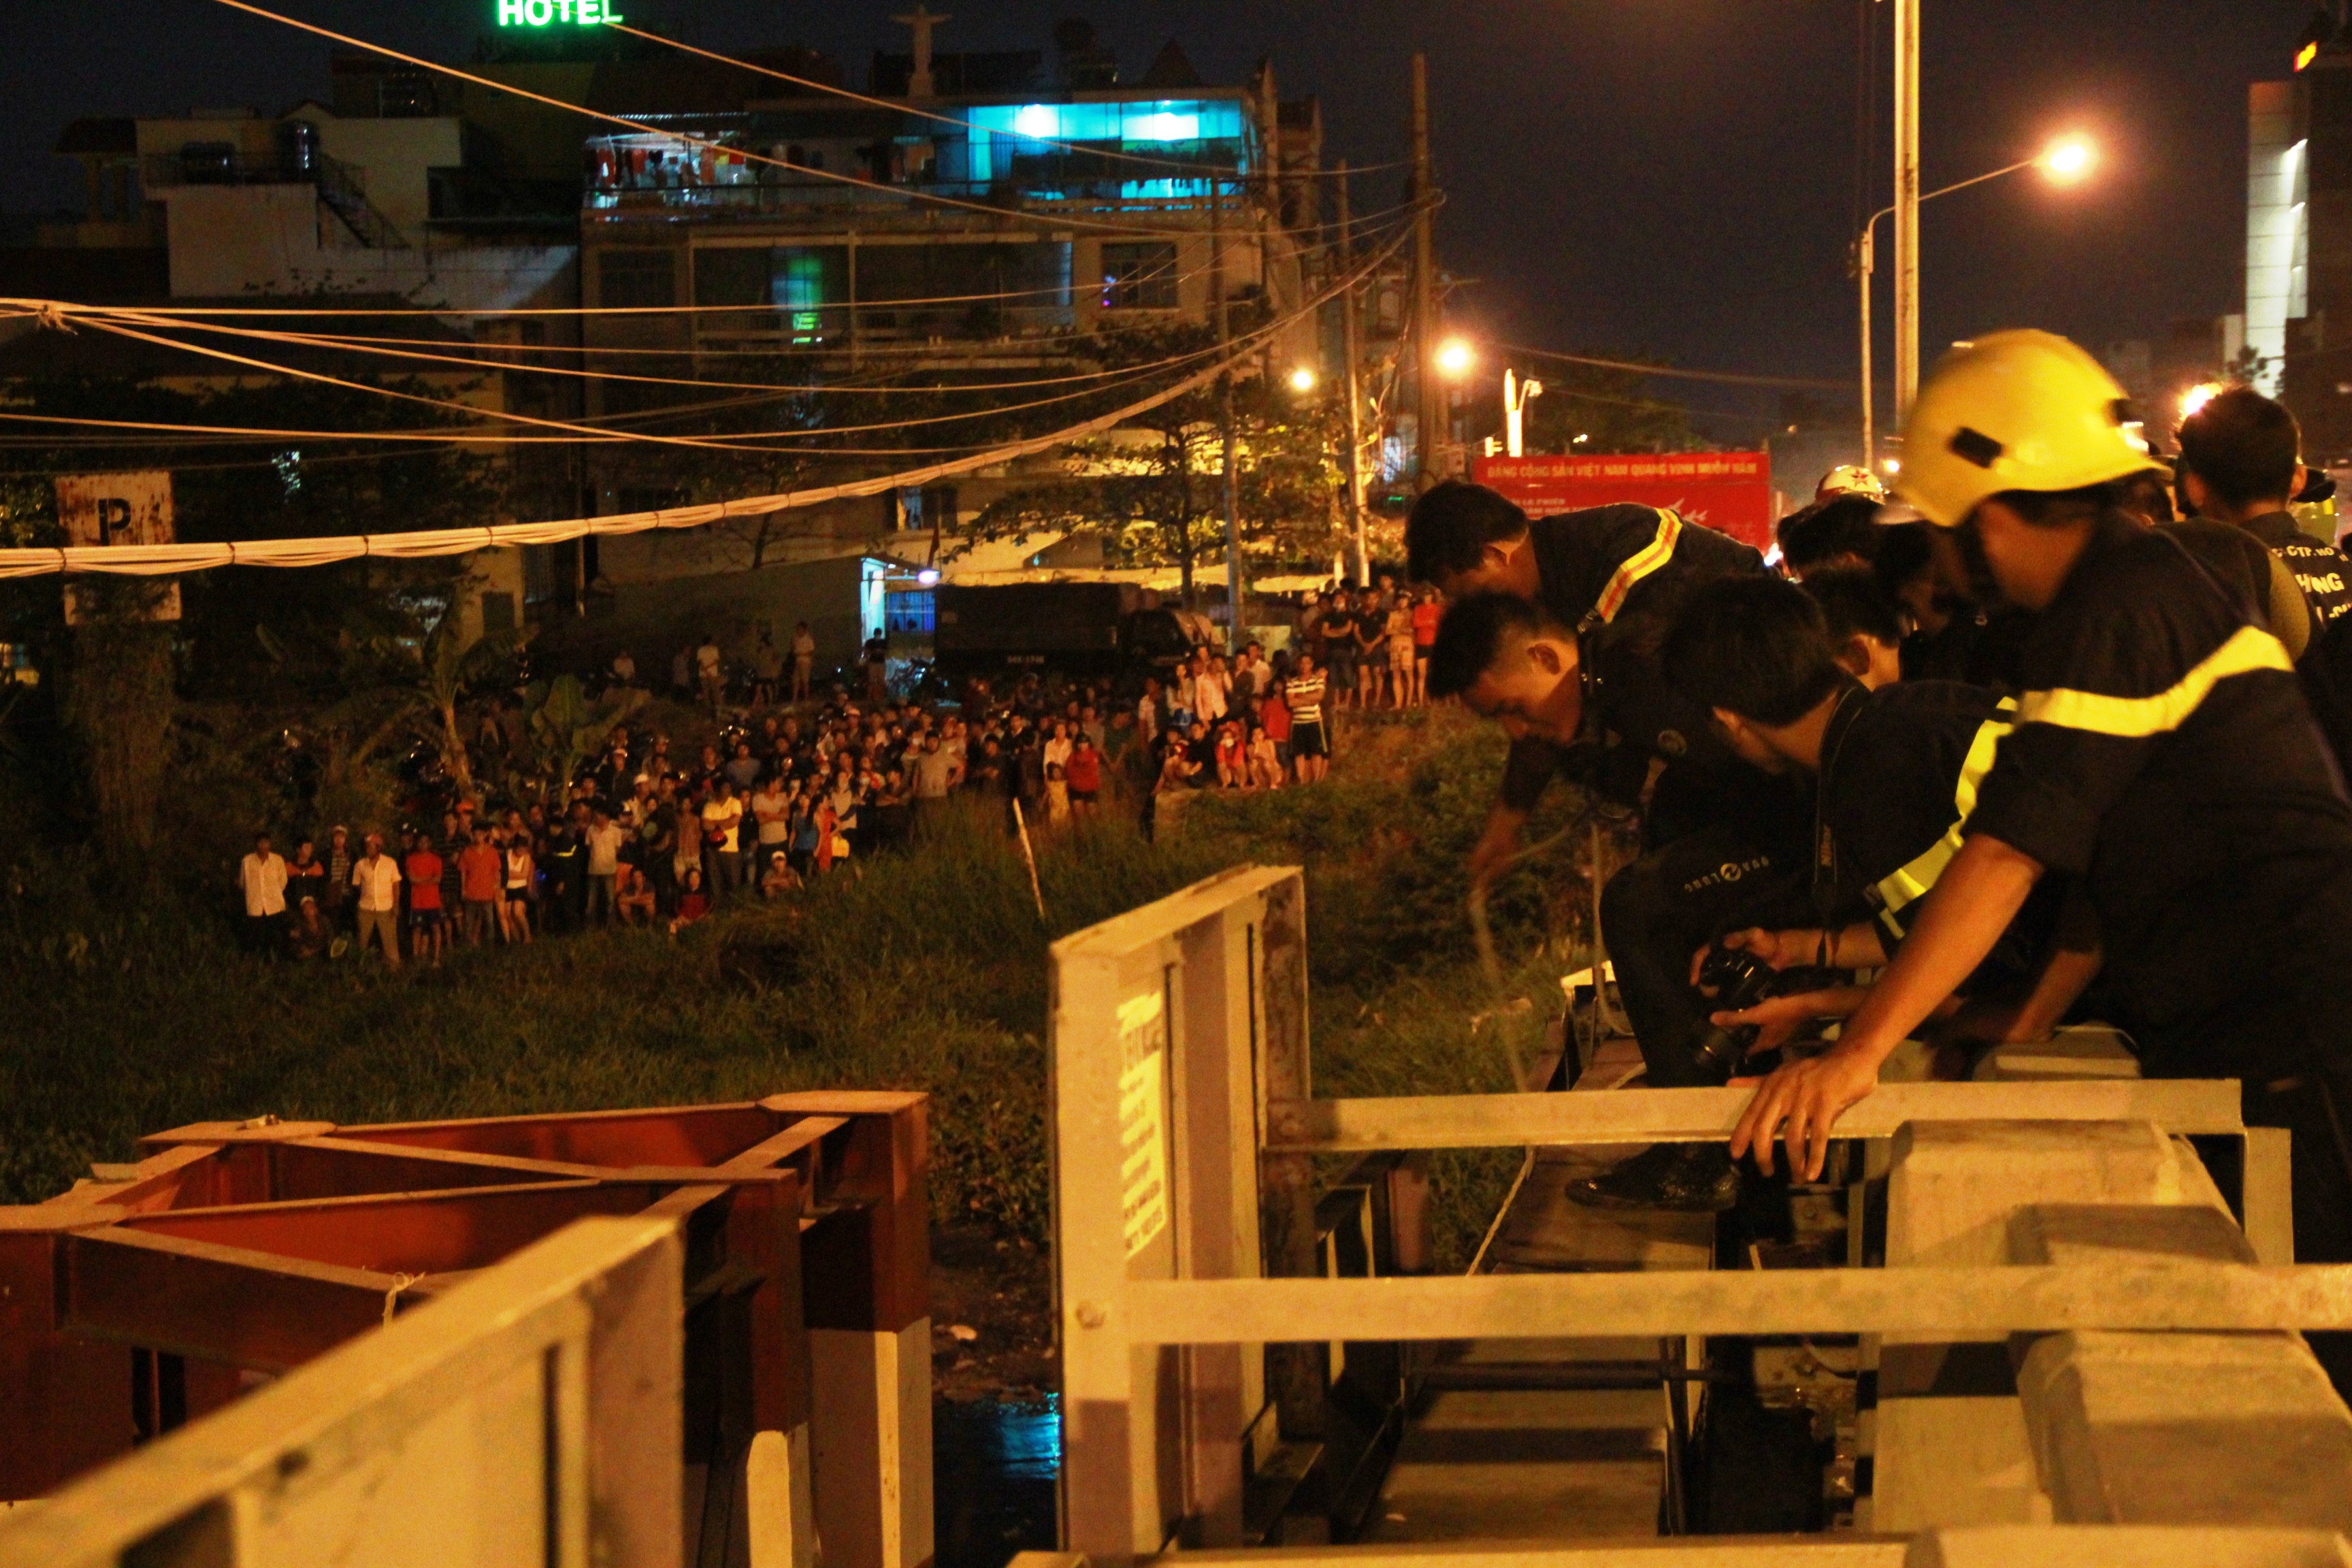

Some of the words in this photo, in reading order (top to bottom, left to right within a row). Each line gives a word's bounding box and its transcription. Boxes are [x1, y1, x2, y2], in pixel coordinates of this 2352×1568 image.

[499, 0, 623, 27] HOTEL
[1604, 464, 1628, 475] NAM
[1631, 463, 1667, 476] QUANG
[98, 498, 132, 546] P
